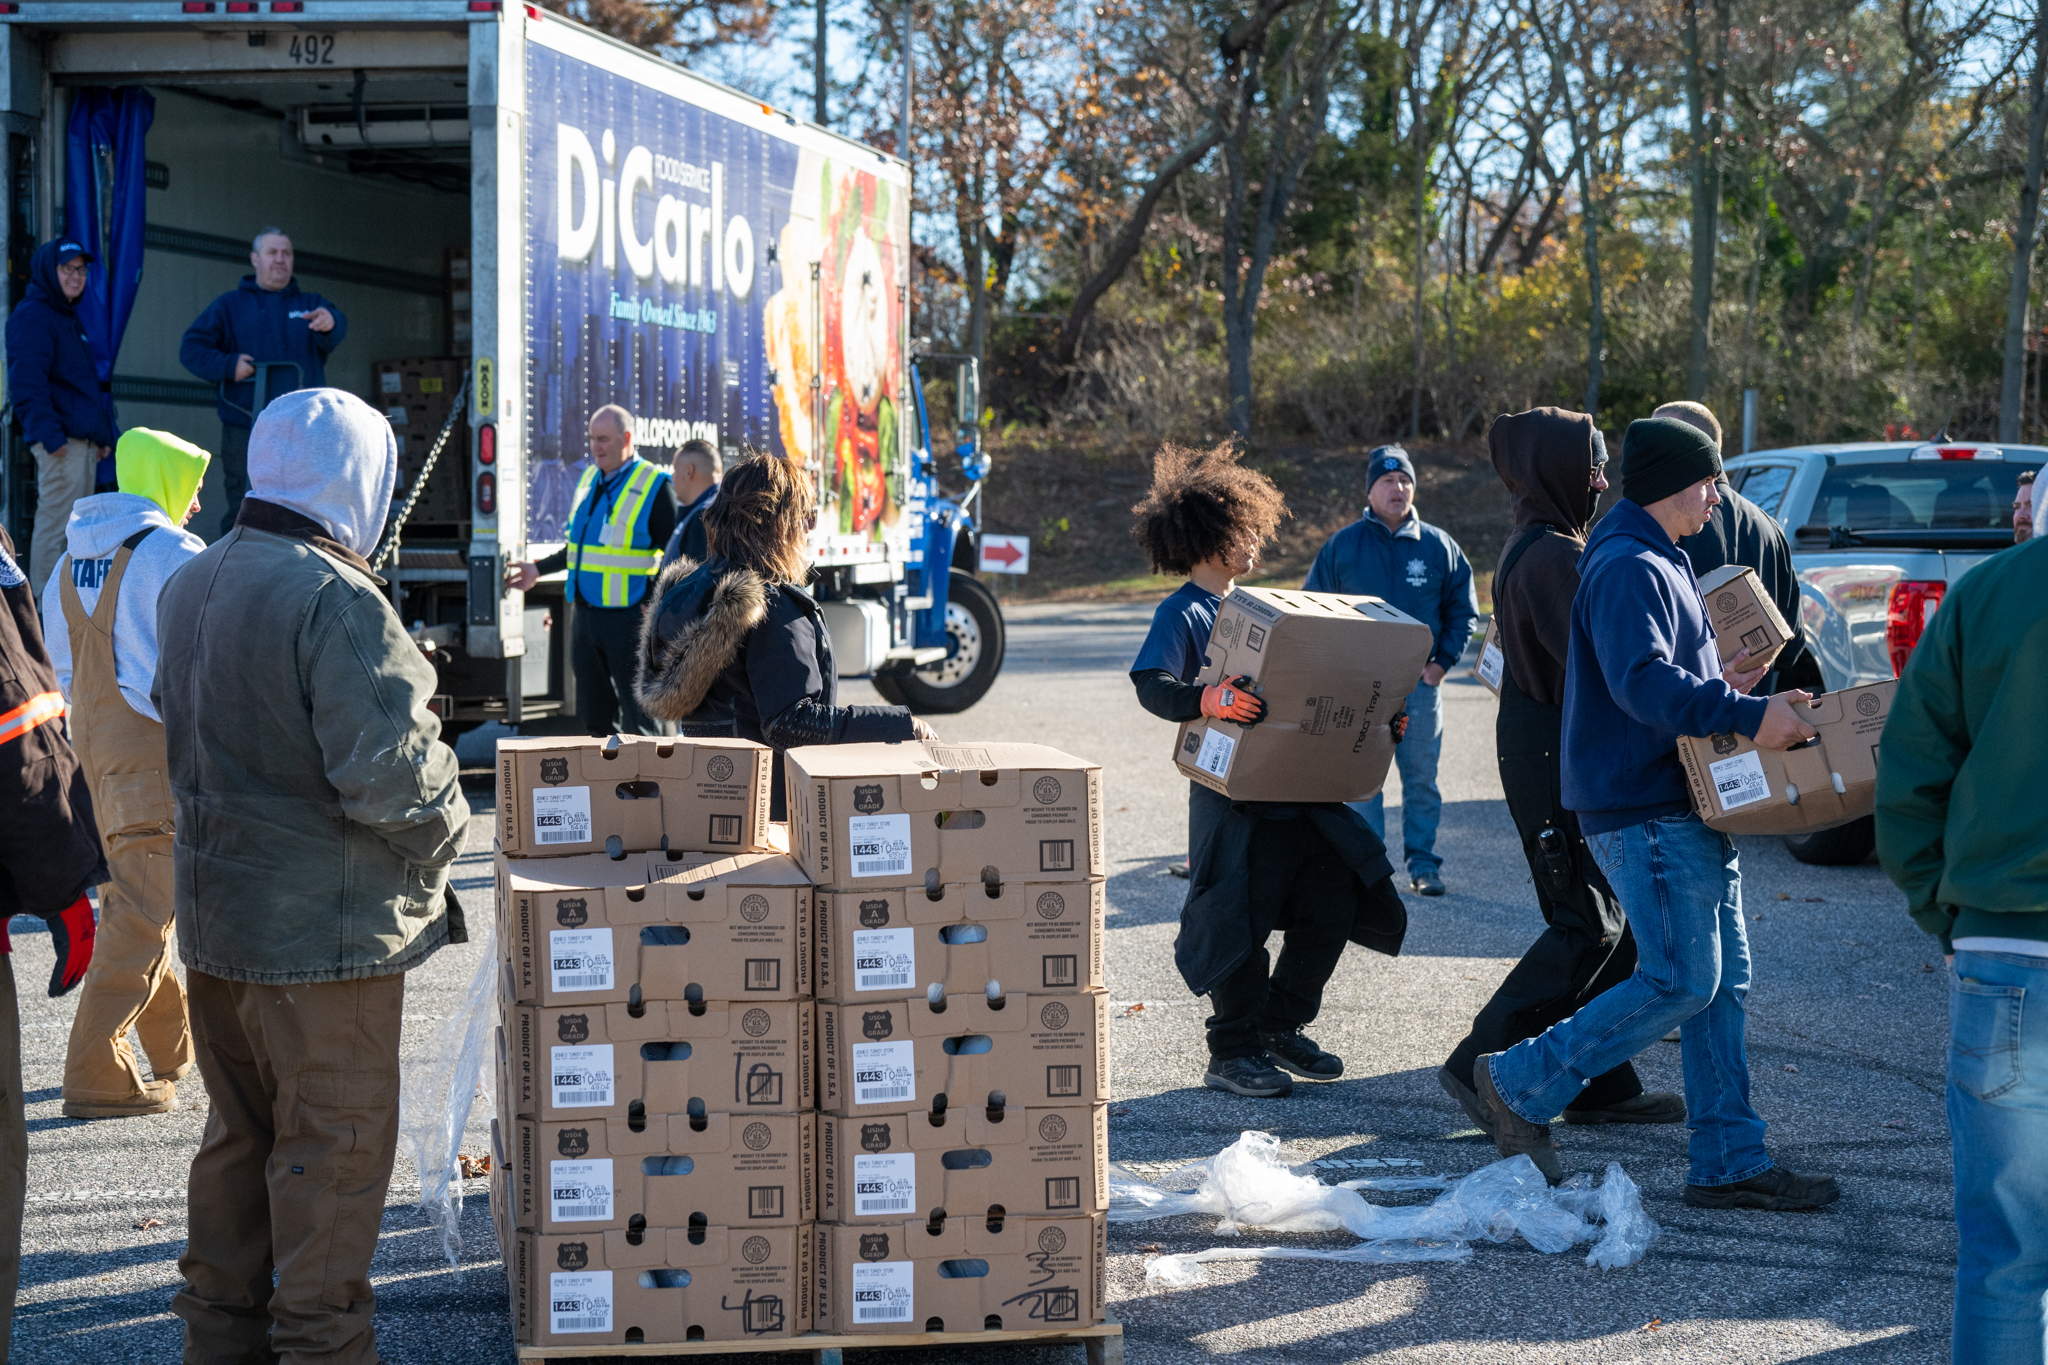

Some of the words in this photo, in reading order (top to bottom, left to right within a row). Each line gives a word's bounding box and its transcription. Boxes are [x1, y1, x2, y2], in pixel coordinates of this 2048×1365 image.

[290, 35, 334, 64] 492
[557, 122, 755, 298] DiCarlo
[609, 292, 641, 327] Family
[642, 298, 674, 327] Owned
[673, 303, 697, 331] Since
[481, 365, 489, 408] MAXON
[72, 558, 113, 588] TAFF
[1252, 604, 1276, 618] PRODUCT
[1365, 690, 1380, 716] Tray
[1373, 681, 1381, 689] 8
[1718, 744, 1735, 752] GRADE
[551, 767, 558, 775] A
[1681, 743, 1696, 777] PRODUCT
[1693, 778, 1700, 788] OF
[1697, 790, 1708, 811] U.S.A.
[504, 760, 512, 801] PRODUCT
[760, 783, 767, 794] OF
[865, 795, 873, 803] A
[505, 803, 513, 815] OF
[817, 785, 827, 829] PRODUCT
[1091, 808, 1098, 819] OF
[758, 797, 766, 837] PRODUCT
[819, 831, 828, 844] OF
[569, 909, 576, 917] A
[871, 910, 878, 918] A
[520, 899, 529, 944] PRODUCT
[819, 900, 828, 944] PRODUCT
[800, 926, 806, 938] OF
[522, 946, 530, 959] OF
[820, 946, 829, 959] OF
[570, 1025, 577, 1033] A
[874, 1021, 882, 1029] A
[521, 1014, 530, 1058] PRODUCT
[825, 1011, 835, 1056] PRODUCT
[803, 1039, 809, 1051] OF
[522, 1060, 530, 1073] OF
[826, 1058, 835, 1070] OF
[570, 1139, 577, 1147] A
[825, 1122, 833, 1166] PRODUCT
[872, 1133, 880, 1142] A
[523, 1127, 531, 1171] PRODUCT
[804, 1152, 810, 1164] OF
[523, 1173, 531, 1186] OF
[825, 1168, 834, 1180] OF
[871, 1243, 878, 1251] A
[569, 1253, 577, 1261] A
[802, 1260, 808, 1272] OF
[819, 1278, 827, 1291] OF
[519, 1287, 526, 1299] OF
